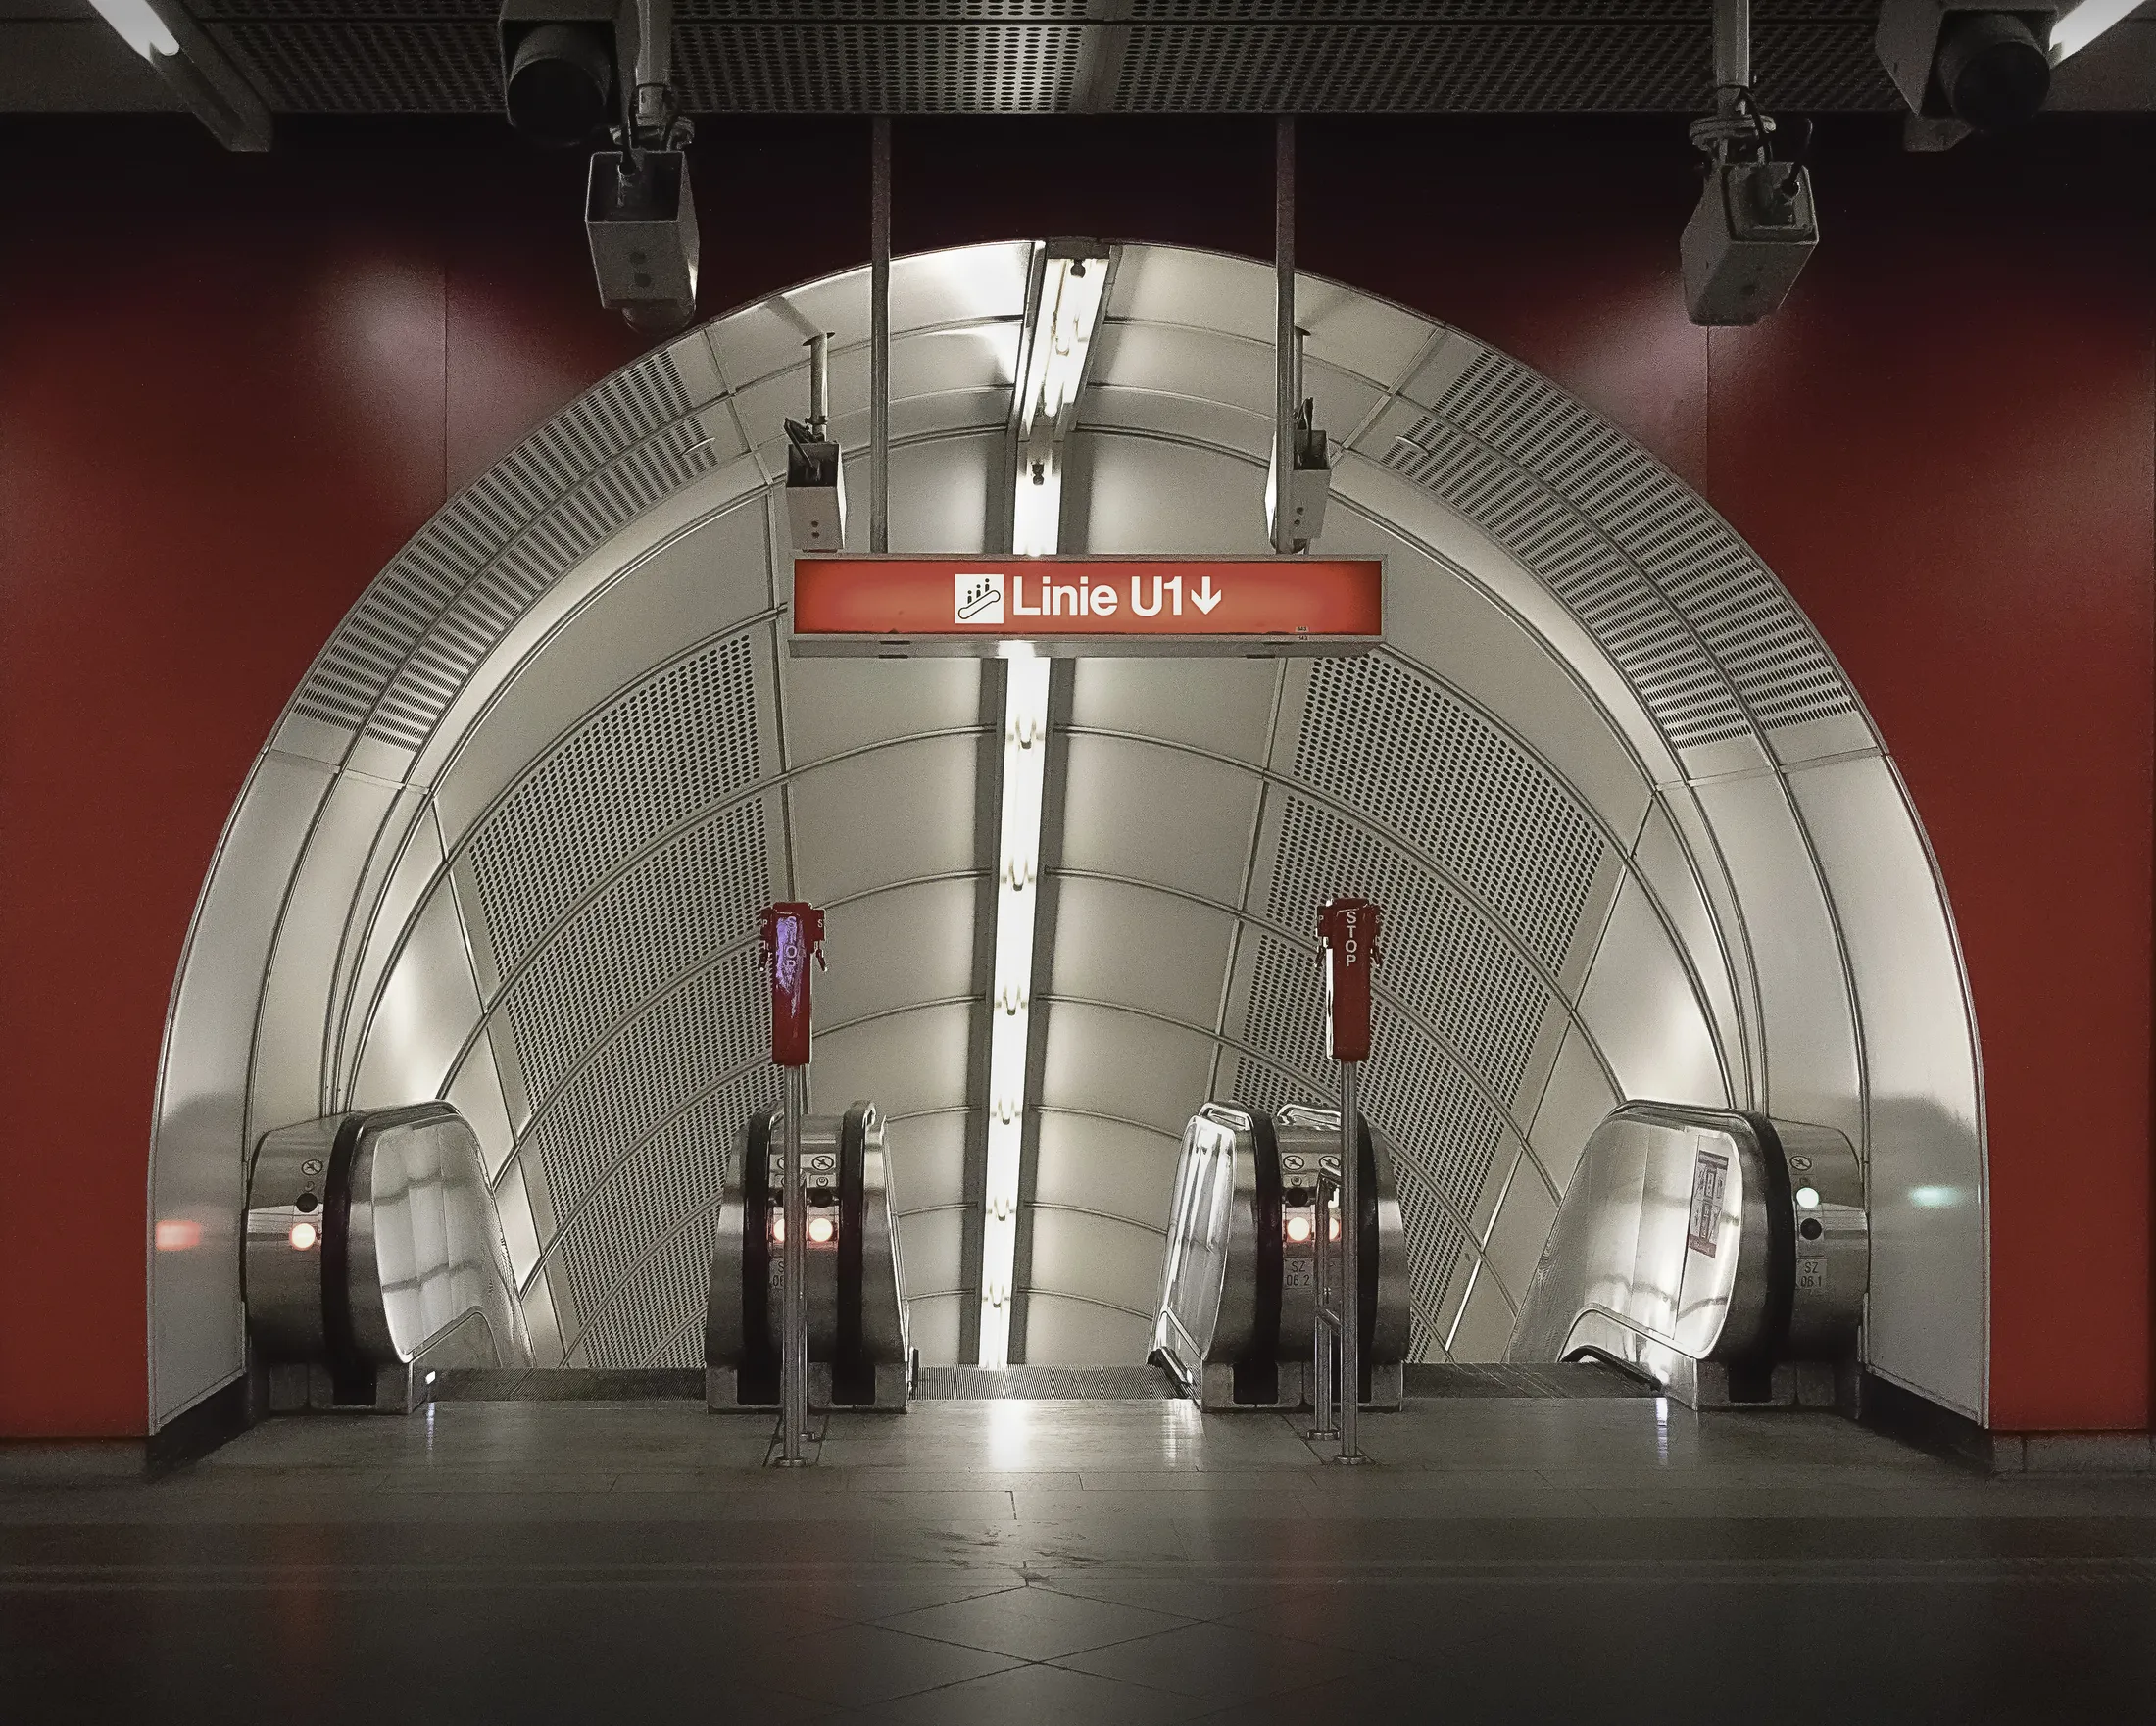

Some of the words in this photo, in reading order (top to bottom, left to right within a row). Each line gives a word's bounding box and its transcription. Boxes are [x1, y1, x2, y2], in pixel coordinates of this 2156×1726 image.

[1013, 576, 1118, 616] Linie
[1131, 576, 1182, 616] U1
[1345, 911, 1358, 967] STOP
[1291, 1260, 1306, 1273] SZ
[1804, 1261, 1819, 1273] SZ
